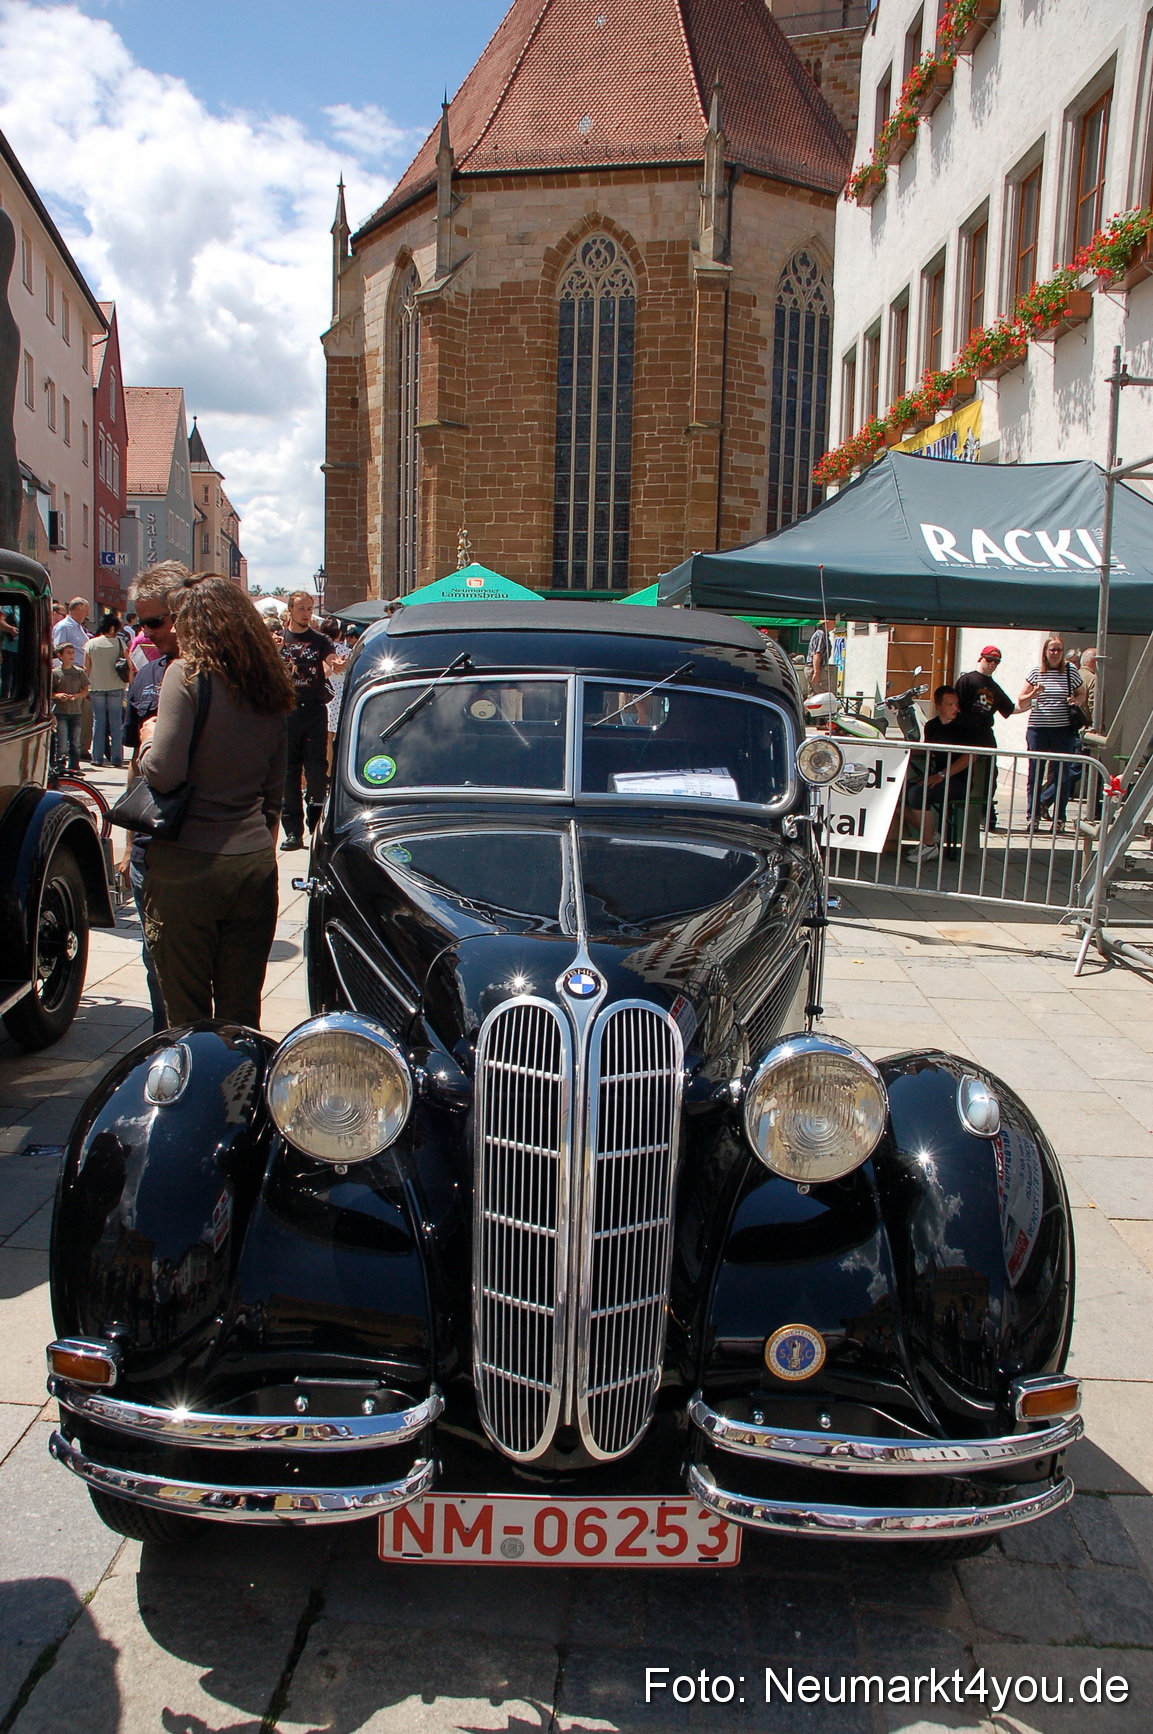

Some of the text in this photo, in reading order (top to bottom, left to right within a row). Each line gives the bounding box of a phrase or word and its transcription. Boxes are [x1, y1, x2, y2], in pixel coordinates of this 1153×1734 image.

[146, 512, 157, 563] satz
[919, 523, 1127, 570] RACKL
[392, 1502, 729, 1557] NM-06253
